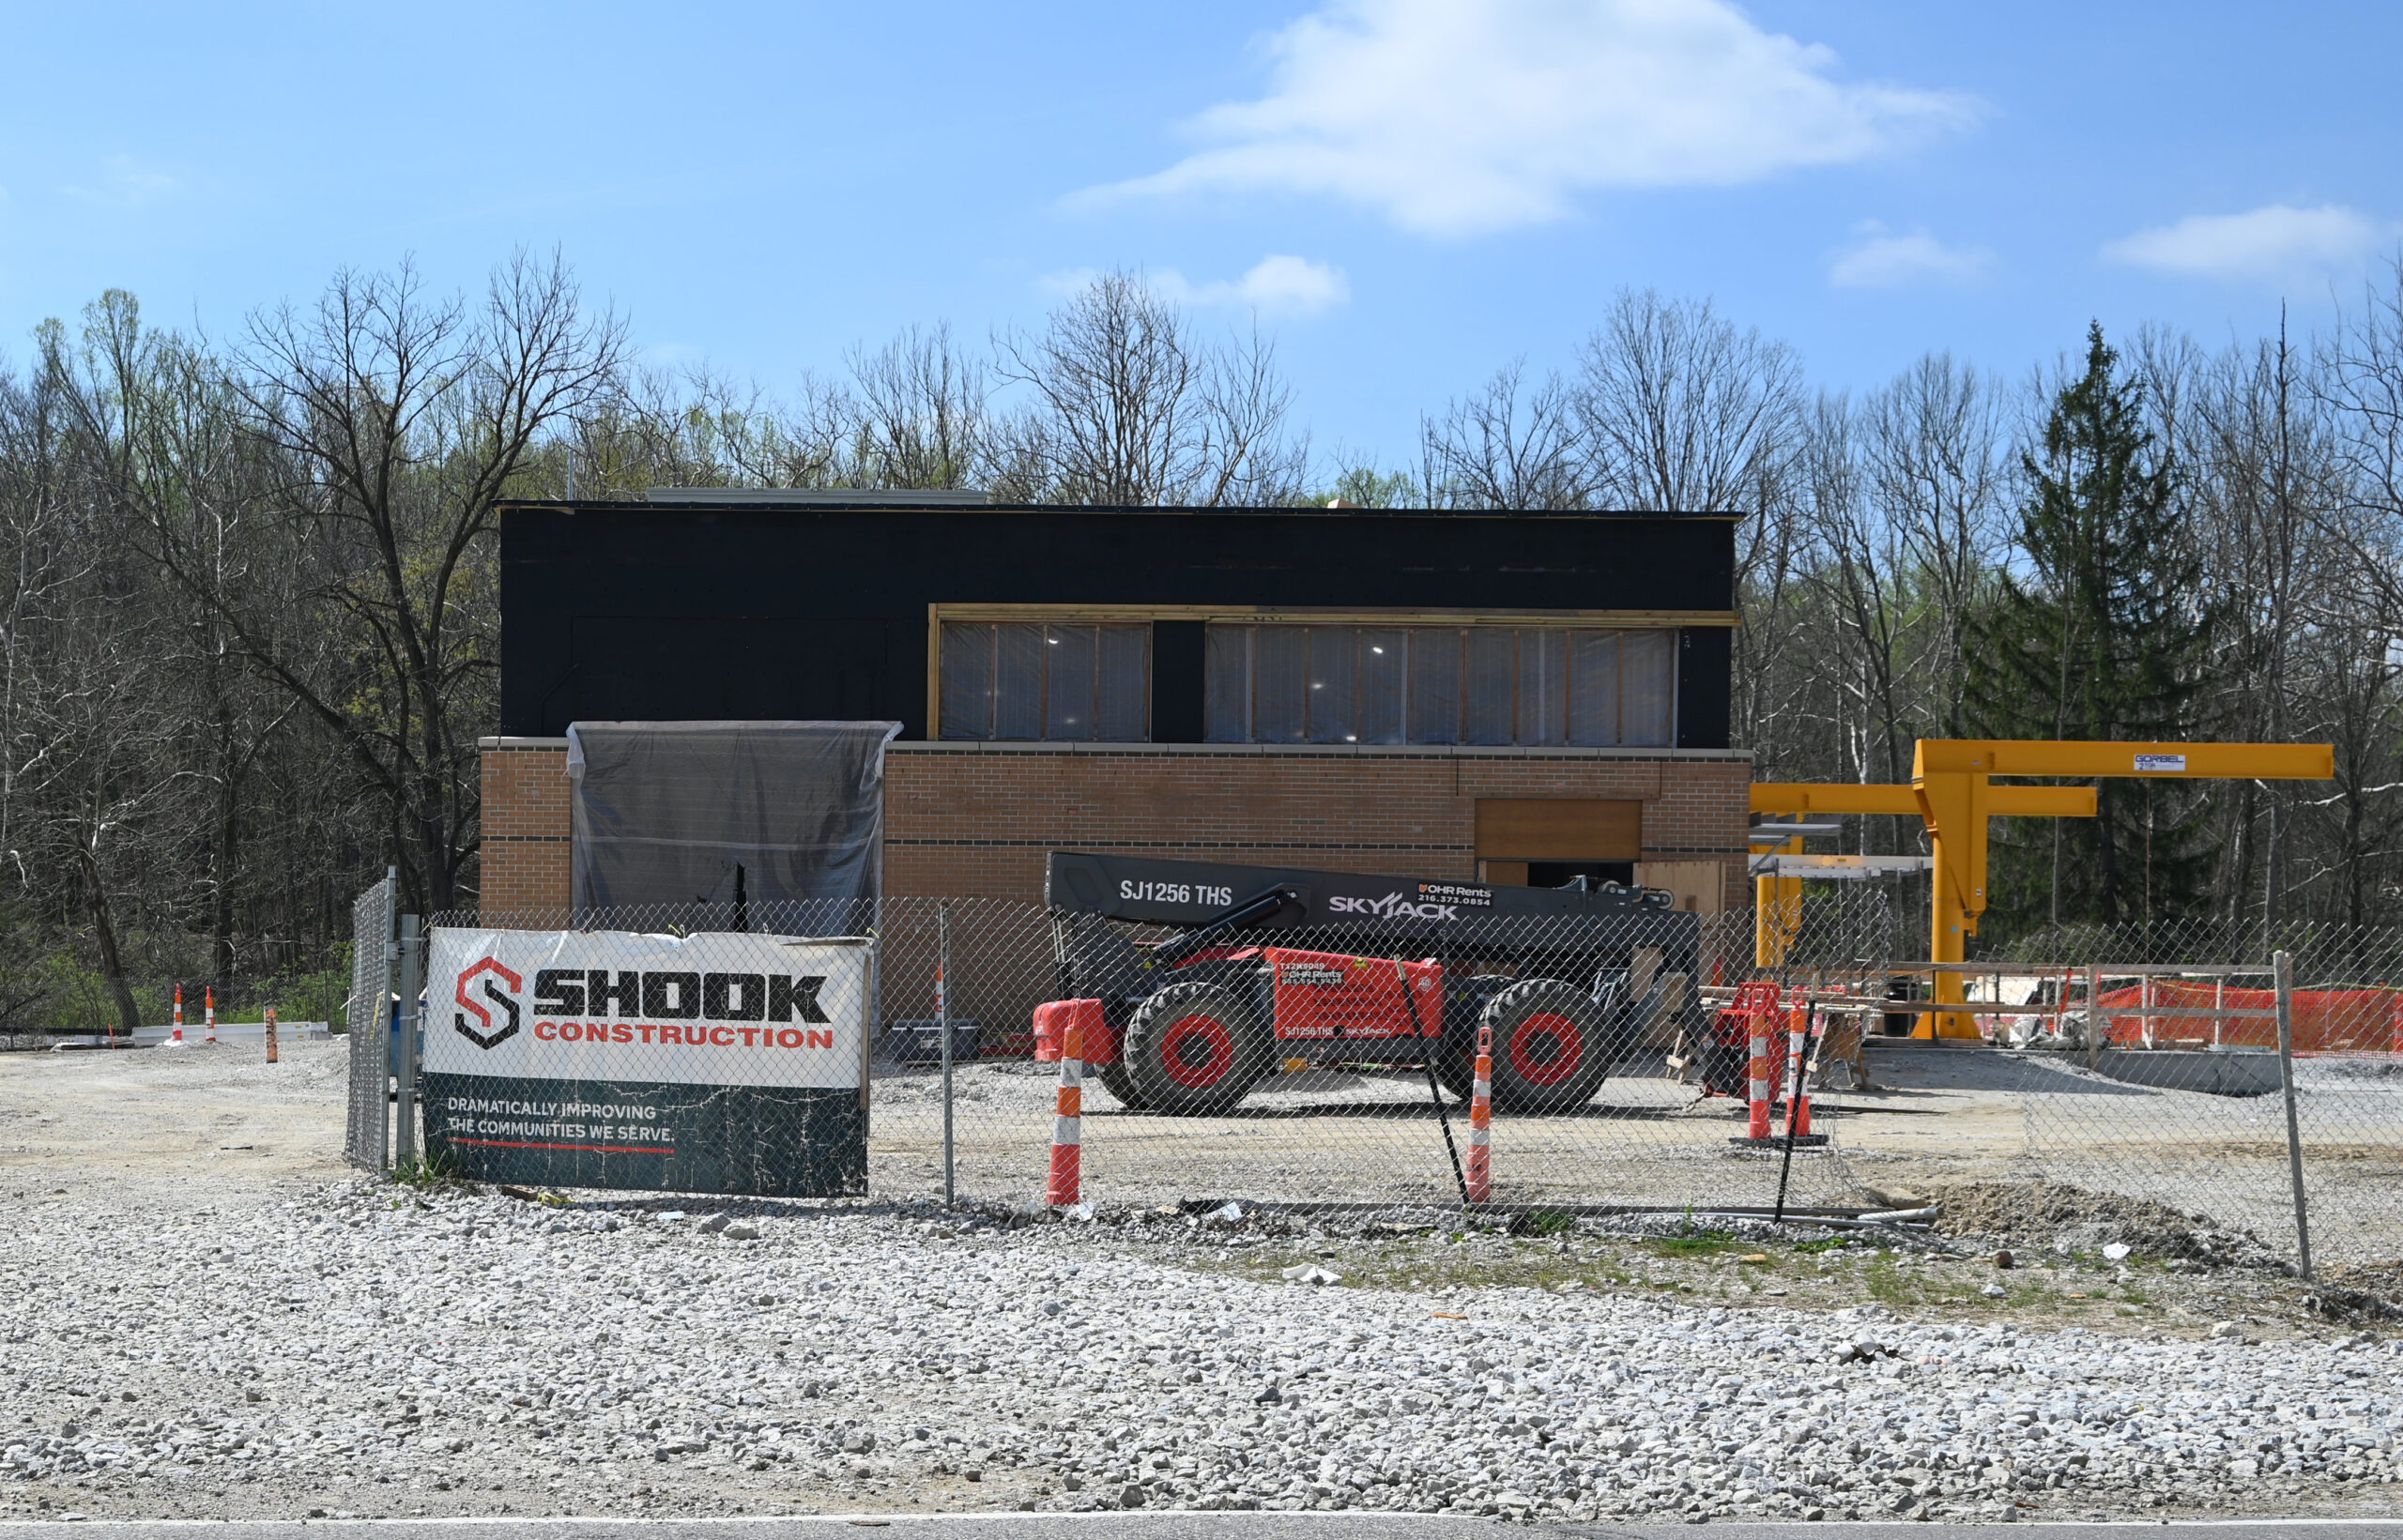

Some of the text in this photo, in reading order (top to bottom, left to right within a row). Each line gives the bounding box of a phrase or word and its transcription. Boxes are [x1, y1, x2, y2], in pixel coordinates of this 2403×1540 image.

[2135, 755, 2184, 763] GORBEL
[1120, 879, 1232, 907] SJ1256 THS
[1418, 894, 1491, 906] 216.373.0854
[1428, 885, 1492, 898] OHR Rents
[1329, 892, 1460, 922] SKYJACK
[534, 969, 832, 1023] SHOOK
[534, 1022, 834, 1048] CONSTRUCTION
[1318, 1027, 1334, 1035] THS
[448, 1097, 657, 1120] DRAMATICALLY IMPROVING
[448, 1118, 675, 1142] THE COMMUNITIES WE SERVE.
